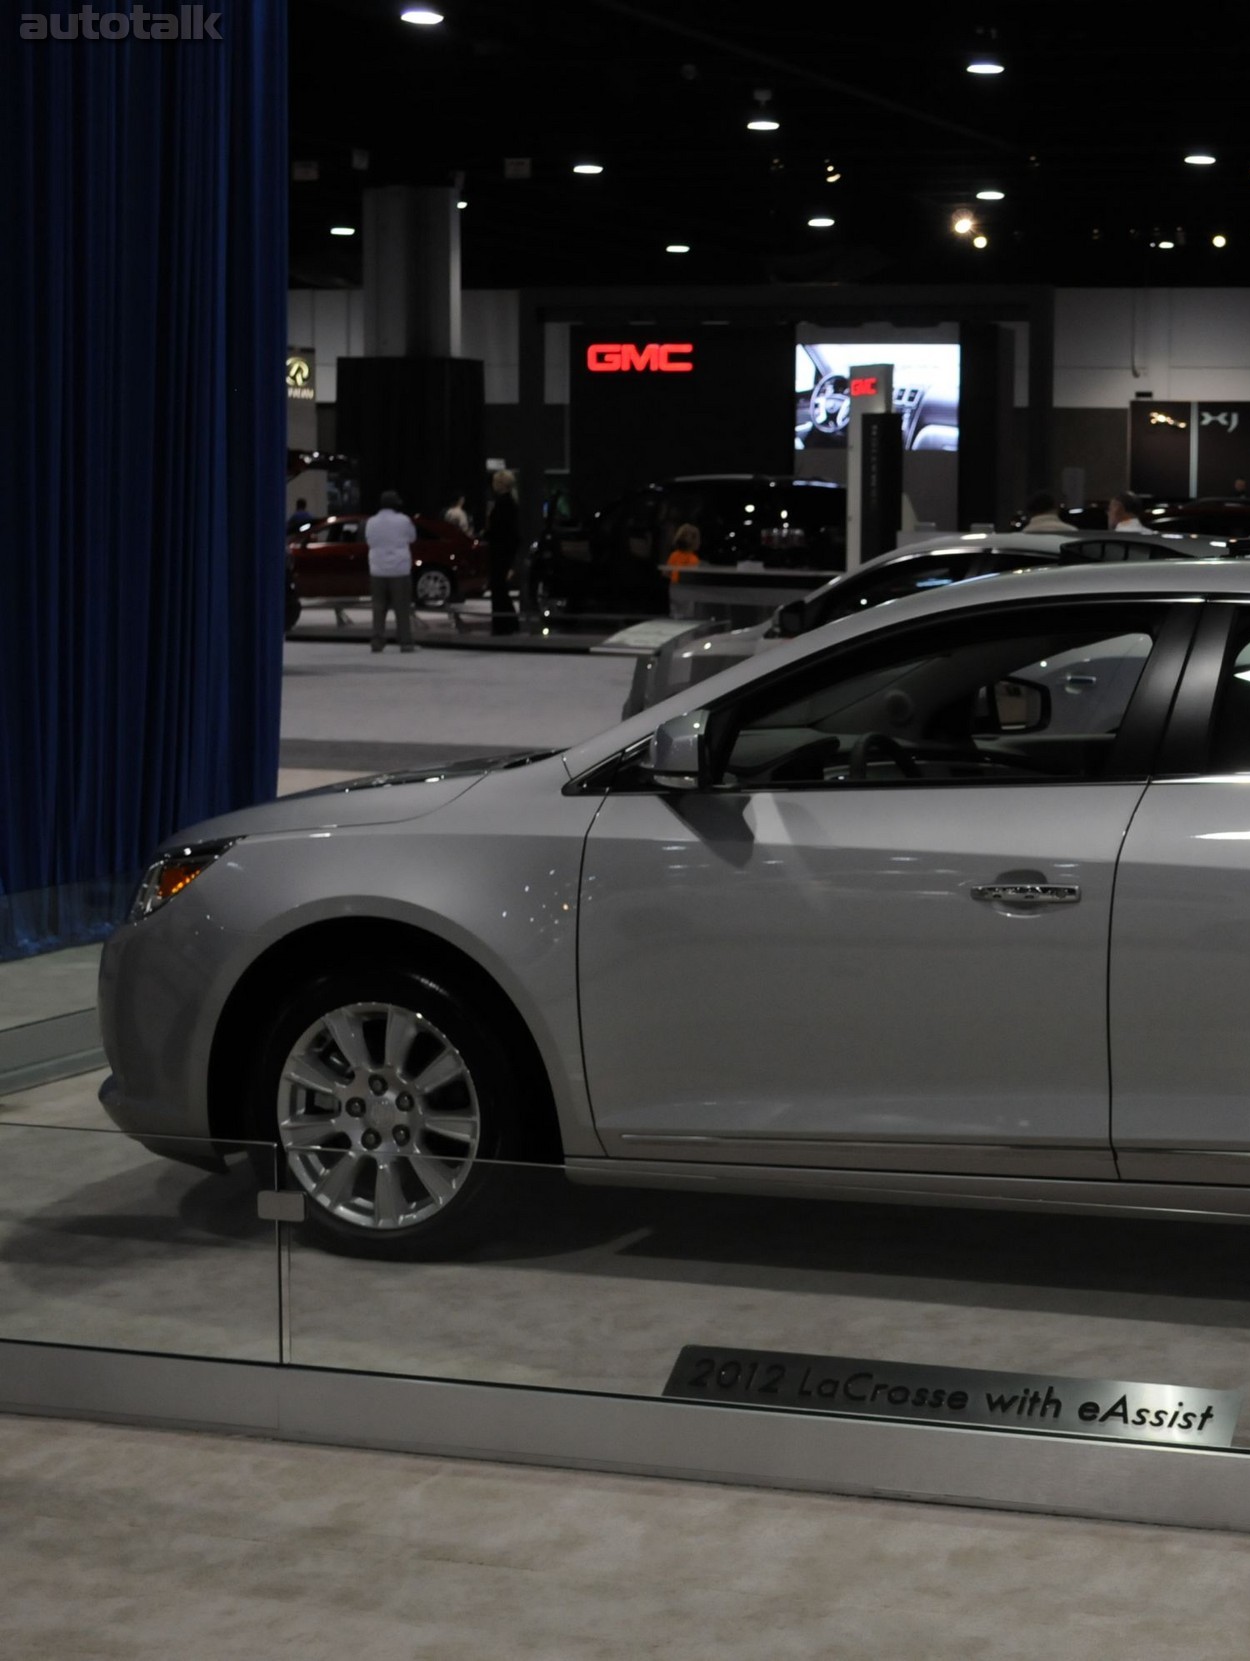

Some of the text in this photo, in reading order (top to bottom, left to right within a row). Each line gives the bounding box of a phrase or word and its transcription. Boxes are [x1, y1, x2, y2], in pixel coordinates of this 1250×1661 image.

[586, 343, 694, 373] GMC
[850, 377, 877, 396] GMC
[687, 1358, 1214, 1431] 2012 LaCrosse with eAssist
